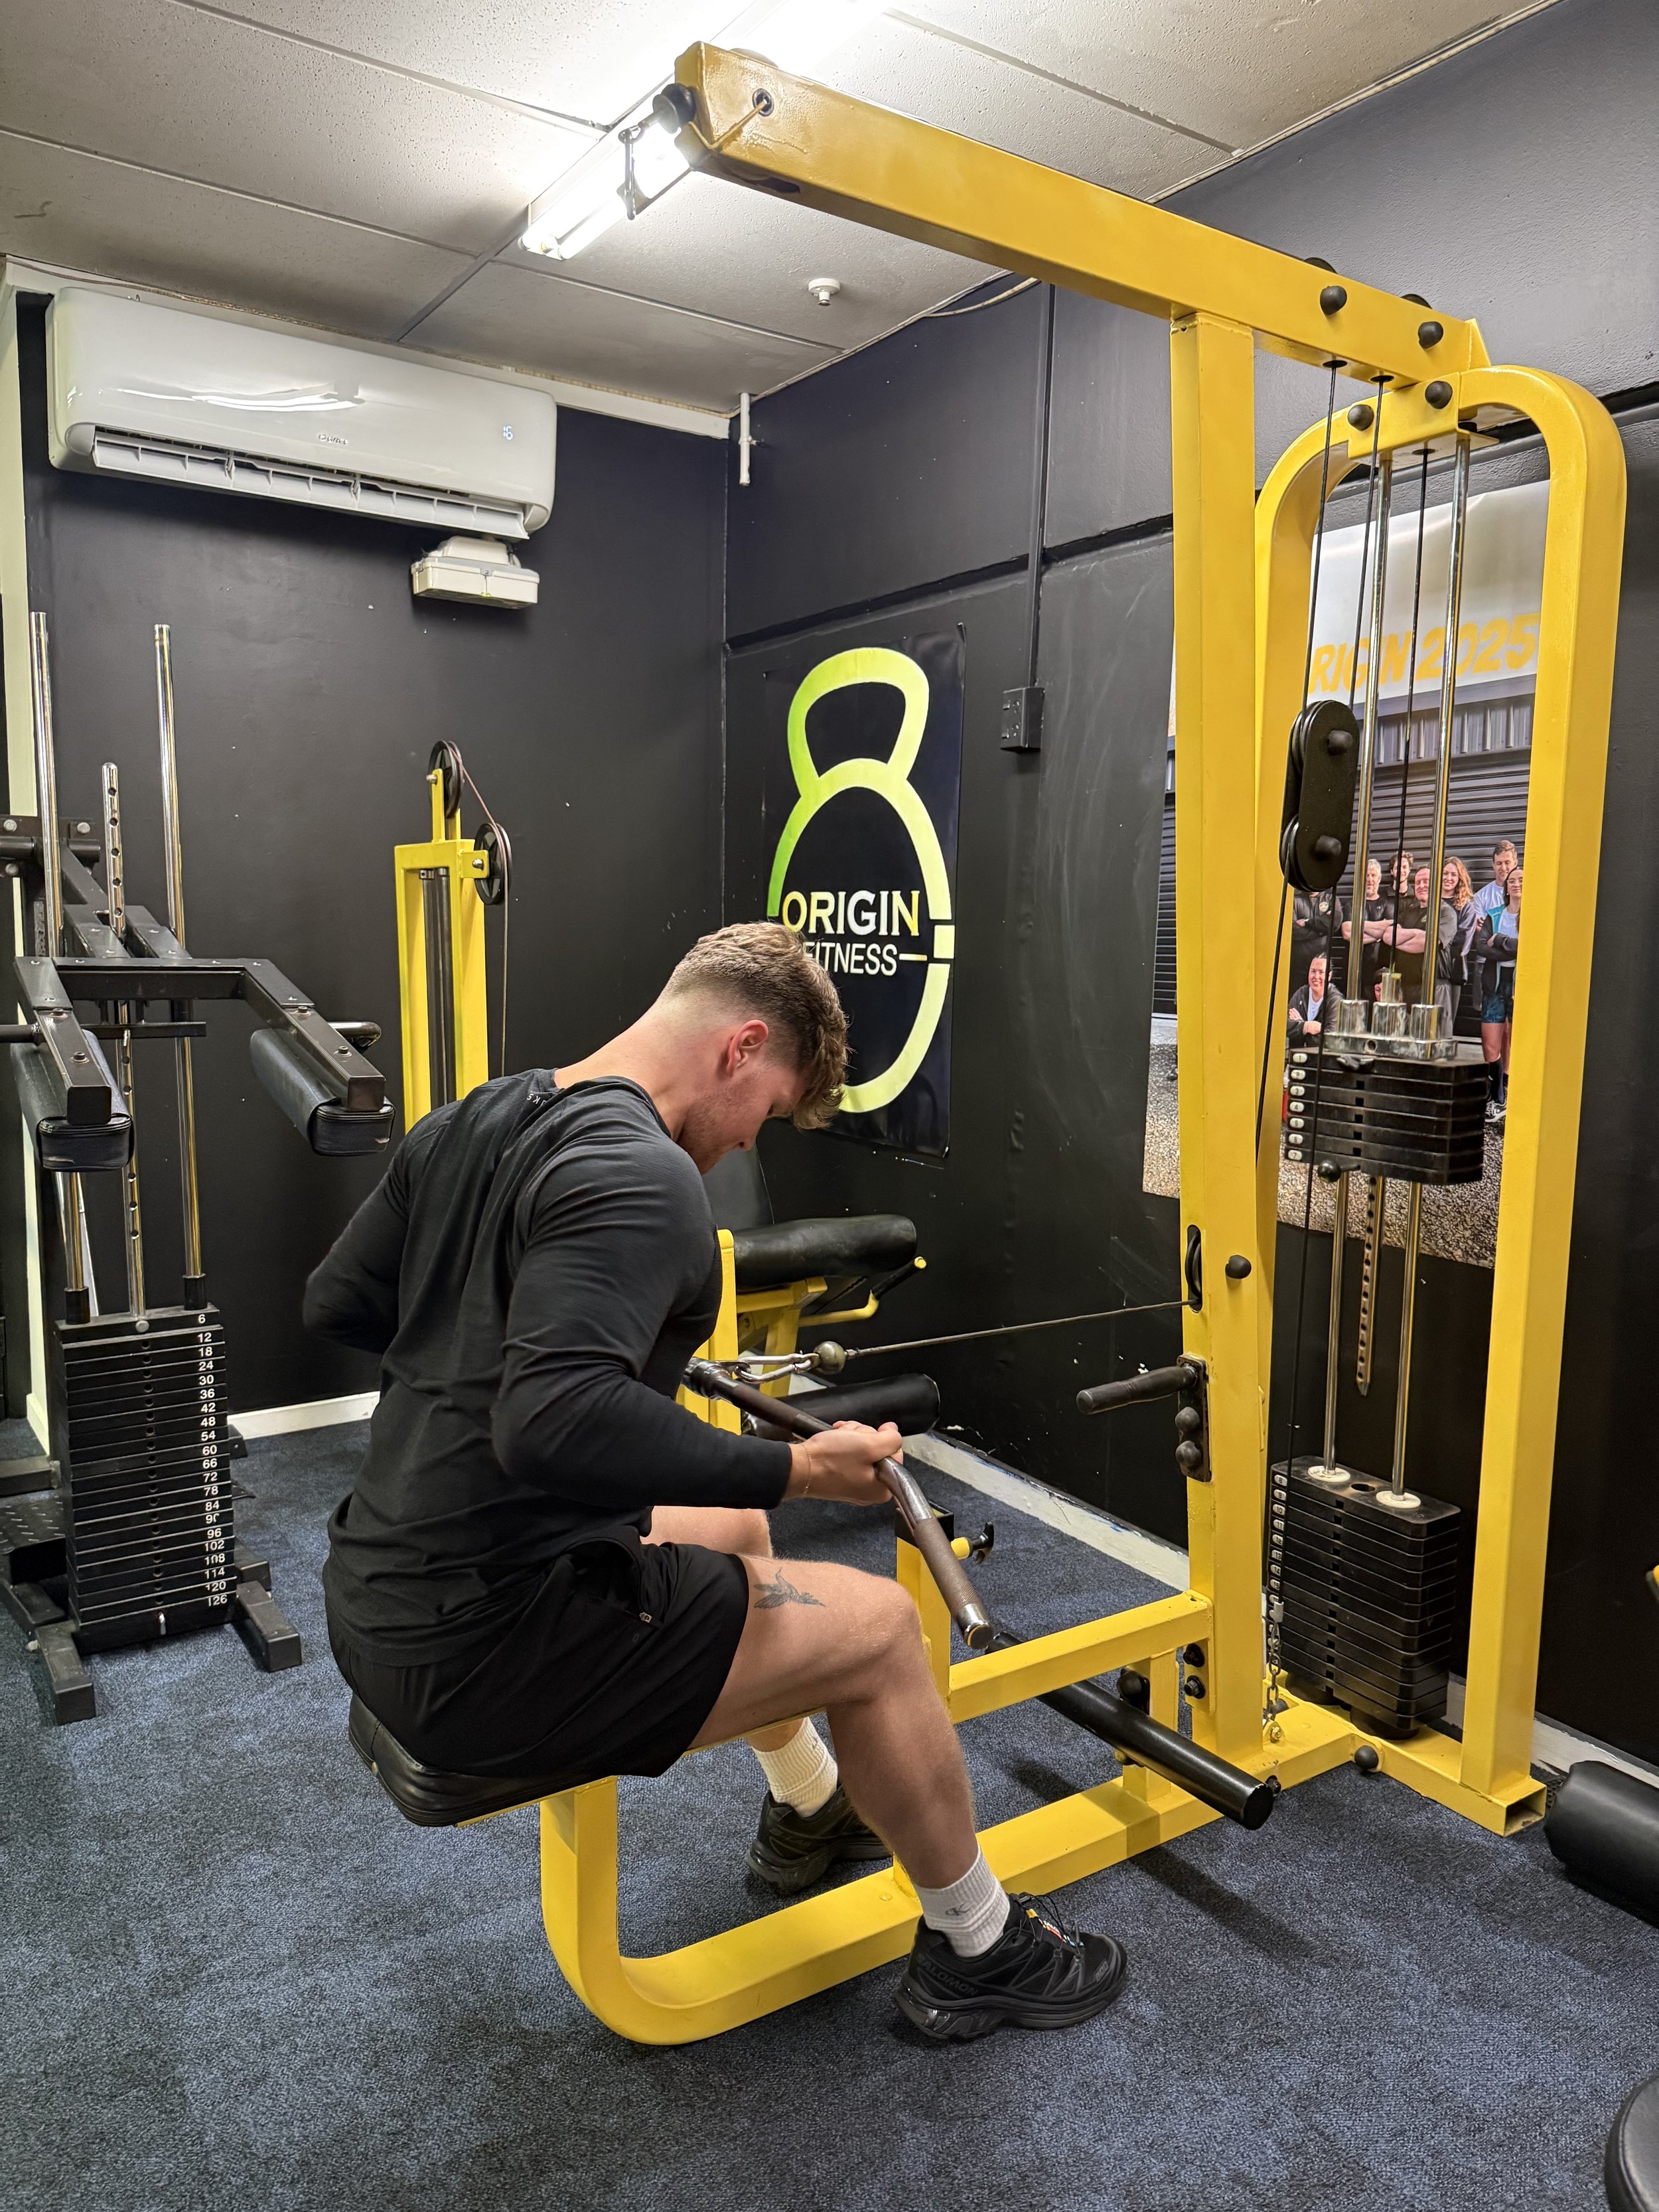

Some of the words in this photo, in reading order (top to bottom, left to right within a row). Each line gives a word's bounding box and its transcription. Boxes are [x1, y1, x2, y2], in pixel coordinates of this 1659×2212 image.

[503, 426, 513, 440] 16
[1308, 630, 1413, 695] RIGN
[1415, 613, 1540, 682] 2025
[782, 890, 920, 936] ORIGIN
[198, 1313, 206, 1324] 6
[198, 1332, 212, 1343] 12
[198, 1347, 213, 1357] 18
[198, 1361, 214, 1371] 24
[199, 1374, 214, 1386] 30
[200, 1388, 215, 1399] 36
[201, 1402, 216, 1413] 42
[201, 1416, 216, 1428] 48
[201, 1430, 216, 1441] 54
[202, 1445, 217, 1455] 60
[202, 1458, 218, 1469] 66
[203, 1471, 218, 1483] 72
[204, 1485, 218, 1497] 78
[205, 1500, 220, 1511] 84
[207, 1528, 222, 1539] 96
[204, 1540, 224, 1552] 102
[204, 1553, 226, 1566] 108
[204, 1567, 225, 1579] 114
[206, 1581, 226, 1592] 120
[208, 1594, 228, 1607] 126
